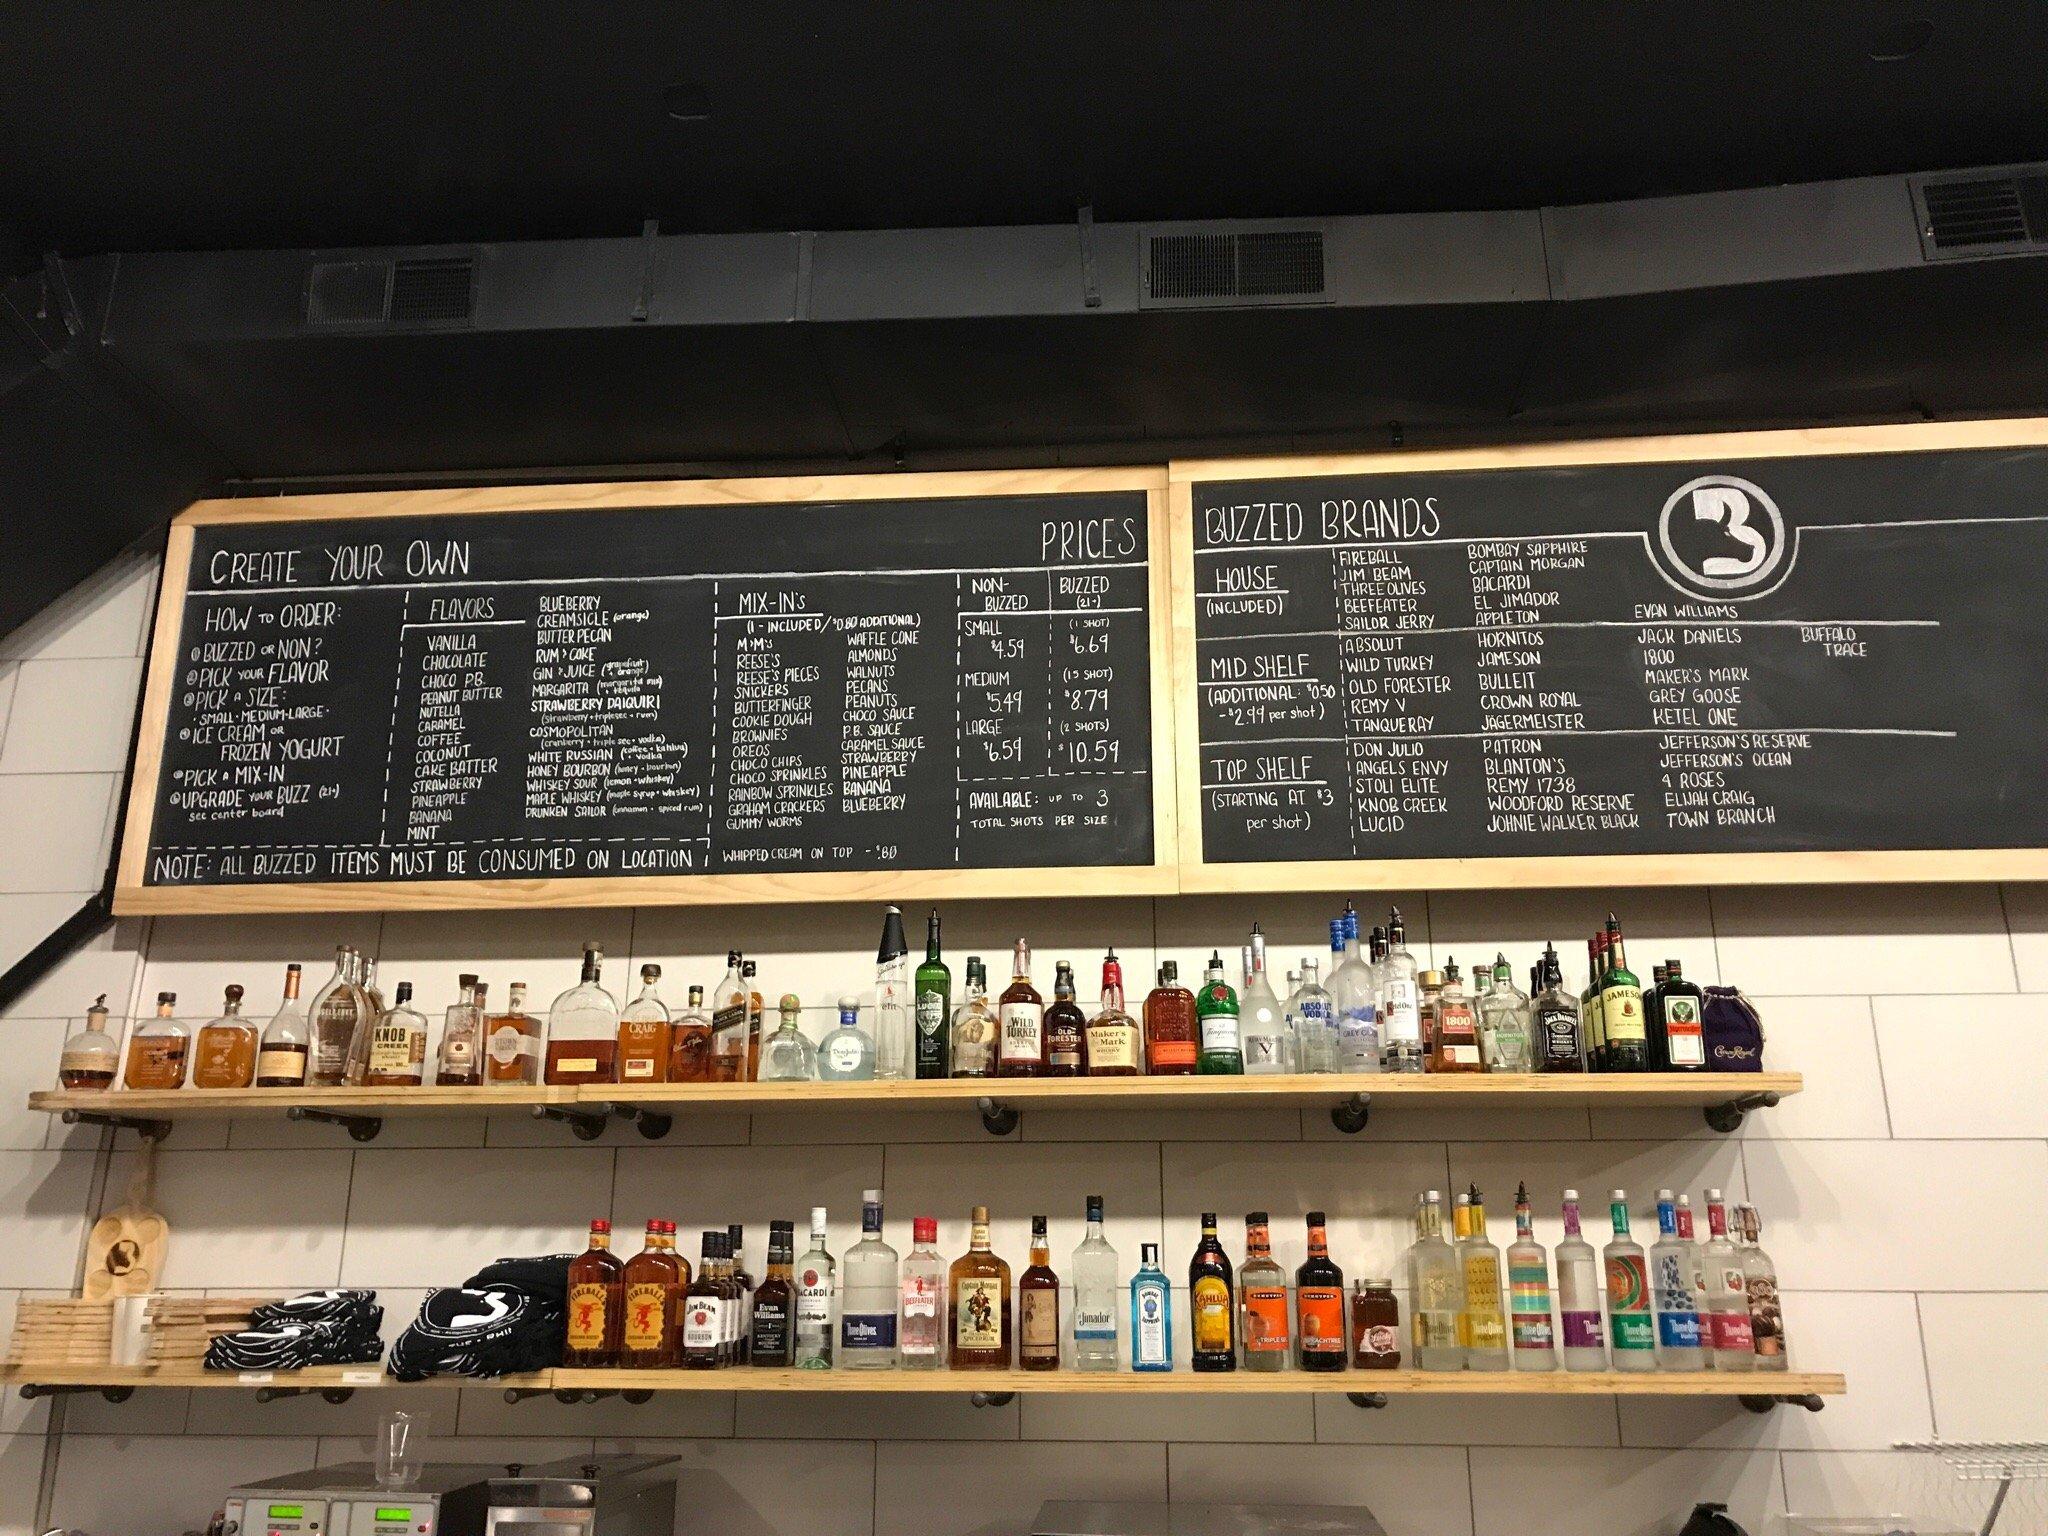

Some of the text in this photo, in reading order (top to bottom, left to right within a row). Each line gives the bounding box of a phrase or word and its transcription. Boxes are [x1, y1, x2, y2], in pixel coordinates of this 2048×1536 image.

[1205, 497, 1440, 544] BUZZED BRANDS
[1042, 518, 1135, 561] PRICES
[210, 540, 469, 584] CREATE YOUR OWN
[1339, 550, 1402, 566] FIREBALL
[1469, 555, 1585, 575] CAPTAIN MORGAN
[1216, 565, 1279, 591] HOUSE
[1338, 566, 1411, 582] JIM BEAM
[972, 577, 1009, 594] NON-
[1060, 576, 1110, 595] BUZZED
[430, 597, 495, 621] FLAVORS
[539, 595, 601, 612] BLUEBERRY
[984, 594, 1029, 612] BUZZED
[1207, 597, 1283, 617] (INCLUDED)
[1344, 598, 1418, 614] BEEFEATER
[1635, 604, 1738, 619] EVAN WILLIAMS
[205, 601, 341, 632] HOW TO ORDER:
[537, 611, 609, 628] CREAMSICLE
[964, 619, 1002, 637] SMALL
[1801, 625, 1856, 643] BUFFALO
[427, 634, 476, 652] VANILLA
[847, 630, 919, 647] WAFFLE CONE
[1477, 631, 1544, 648] HORNITOS
[203, 637, 322, 663] BUZZED OR NON?
[1644, 649, 1675, 665] 1800
[1823, 642, 1867, 657] TRACE
[423, 652, 488, 671] CHOCOLATE
[1211, 654, 1309, 679] MID SHELF
[1346, 655, 1433, 672] WILD TURKEY
[1477, 651, 1541, 668] JAMESON
[199, 660, 329, 688] PICK YOUR FLAVOR
[847, 665, 895, 679] WALNUTS
[965, 671, 1009, 687] MEDIUM
[1645, 667, 1750, 685] MAKER'S MARK
[846, 679, 888, 694] PECANS
[1349, 675, 1451, 695] OLD FORESTER
[1478, 672, 1535, 690] BULLEIT
[734, 683, 789, 699] SNICKERS
[1649, 687, 1741, 704] GREY GOOSE
[530, 695, 660, 712] STRAWBERRY DAIQUIRI
[734, 696, 812, 714] BUTTERFINGER
[845, 693, 897, 709] PEANUTS
[1480, 691, 1581, 711] CROWN ROYAL
[418, 718, 466, 734] CARAMEL
[966, 718, 1004, 736] LARGE
[1351, 716, 1434, 734] TANQUERAY
[417, 732, 462, 748] COFFEE
[732, 728, 788, 743] BROWNIES
[1659, 732, 1812, 750] JEFFERSON'S RESERVE
[220, 736, 345, 762] FROZEN YOGURT
[1483, 738, 1542, 754] PATRON
[528, 748, 613, 763] WHITE RUSSIAN
[1210, 756, 1312, 782] TOP SHELF
[1356, 760, 1448, 777] ANGELS ENVY
[1484, 758, 1566, 777] BLANTON'S
[410, 776, 482, 794] STRAWBERRY
[182, 784, 311, 809] UPGRADE YOUR BUZZ
[411, 792, 468, 808] PINEAPPLE
[843, 793, 906, 813] BLUEBERRY
[969, 790, 1039, 809] AVAILABLE:
[1097, 789, 1108, 807] 3
[1358, 796, 1448, 813] KNOB CREEK
[1487, 794, 1634, 812] WOODFORD RESERVE
[1665, 790, 1755, 807] ELIJAH CRAIG
[970, 814, 1108, 828] TOTAL SHOTS PER SIZE
[1359, 815, 1404, 832] LUCID
[1666, 806, 1775, 828] TOWN BRANCH
[722, 847, 853, 862] WHIPPED CREAM ON TOP
[154, 847, 693, 881] NOTE: ALL BUZZED ITEMS MUST BE CONSUMED ON LOCATION
[1300, 1002, 1332, 1012] ABSOLUT
[1011, 1017, 1033, 1027] WILD
[1445, 1016, 1470, 1026] 1800
[1544, 1015, 1557, 1025] JACK
[375, 1028, 406, 1042] KNOB
[1006, 1025, 1037, 1038] TURKEY
[571, 1284, 605, 1302] FIREBALL
[628, 1284, 663, 1302] FIREBALL
[905, 1297, 934, 1306] BEEFEATER
[687, 1301, 716, 1315] JIM BEAM
[753, 1311, 785, 1319] Williams
[759, 1303, 778, 1311] Evan
